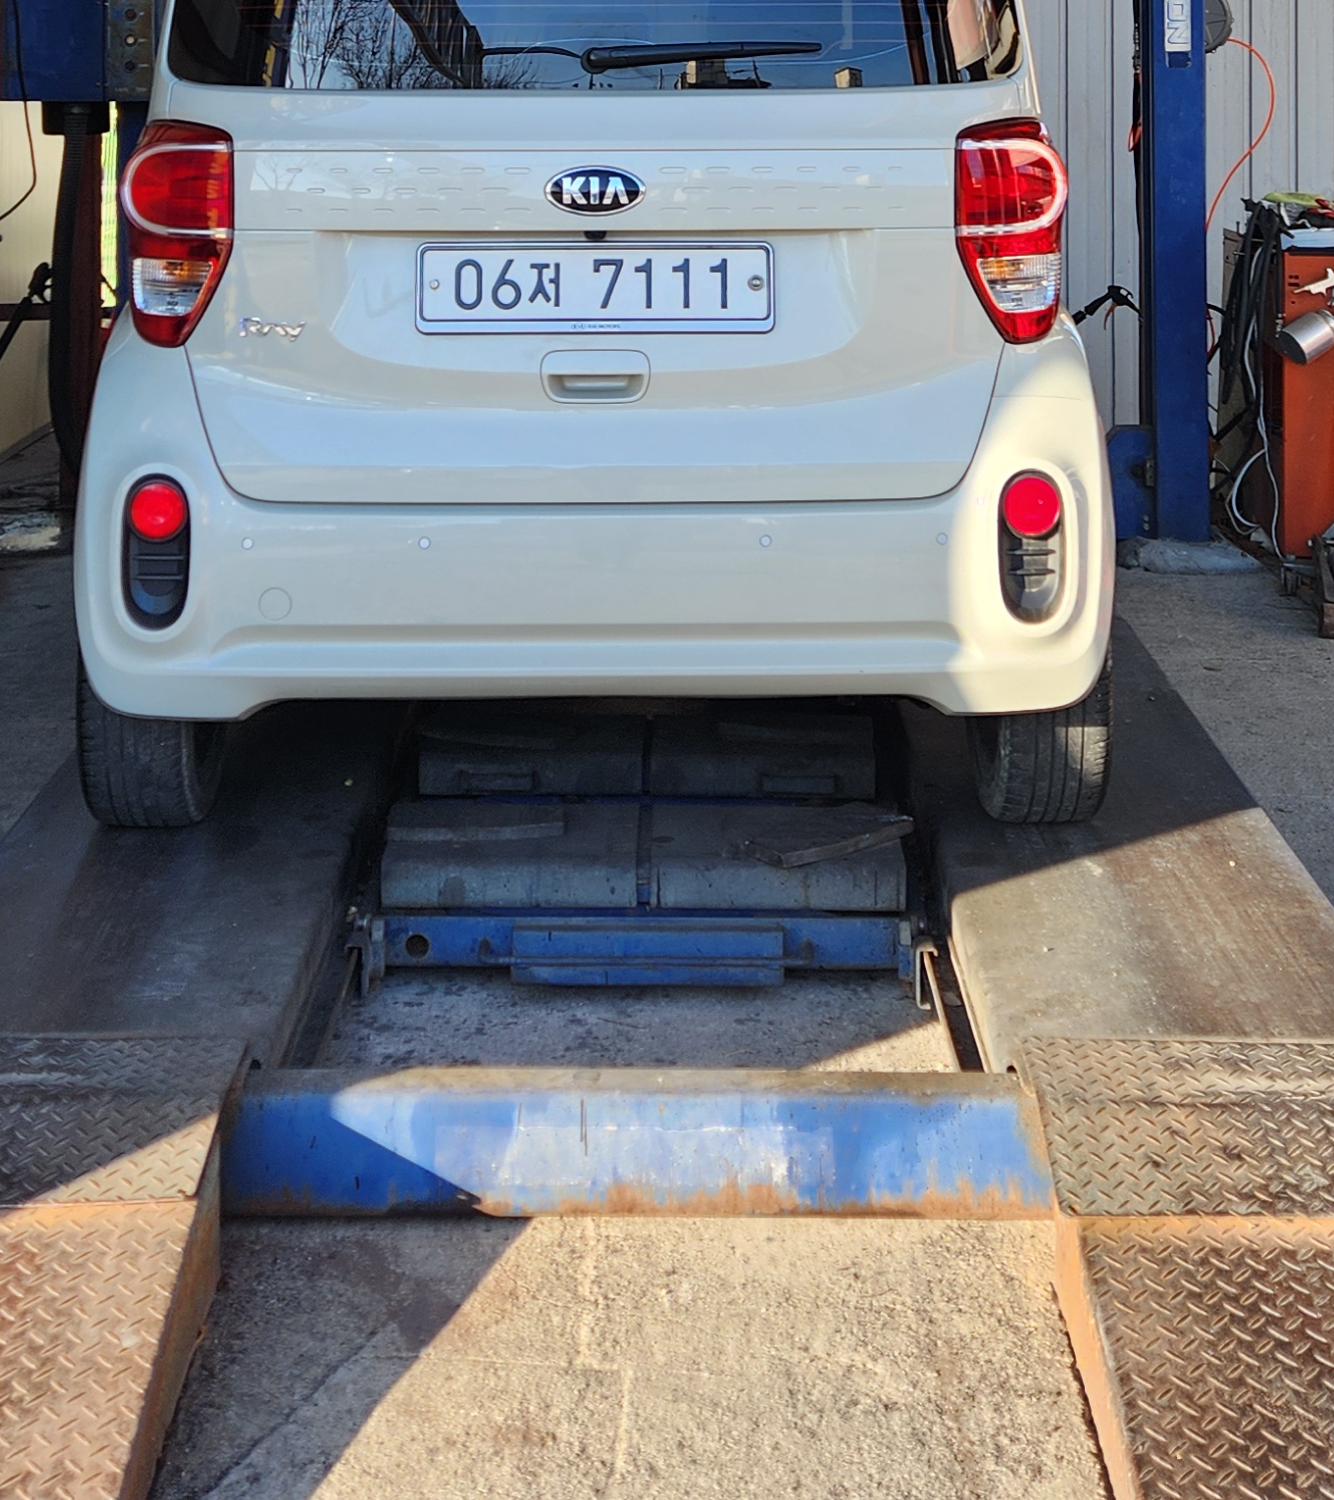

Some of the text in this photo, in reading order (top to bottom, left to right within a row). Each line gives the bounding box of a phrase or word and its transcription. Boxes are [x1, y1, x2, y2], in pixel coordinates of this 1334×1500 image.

[561, 176, 630, 205] KIA
[454, 258, 729, 311] 06저 7111
